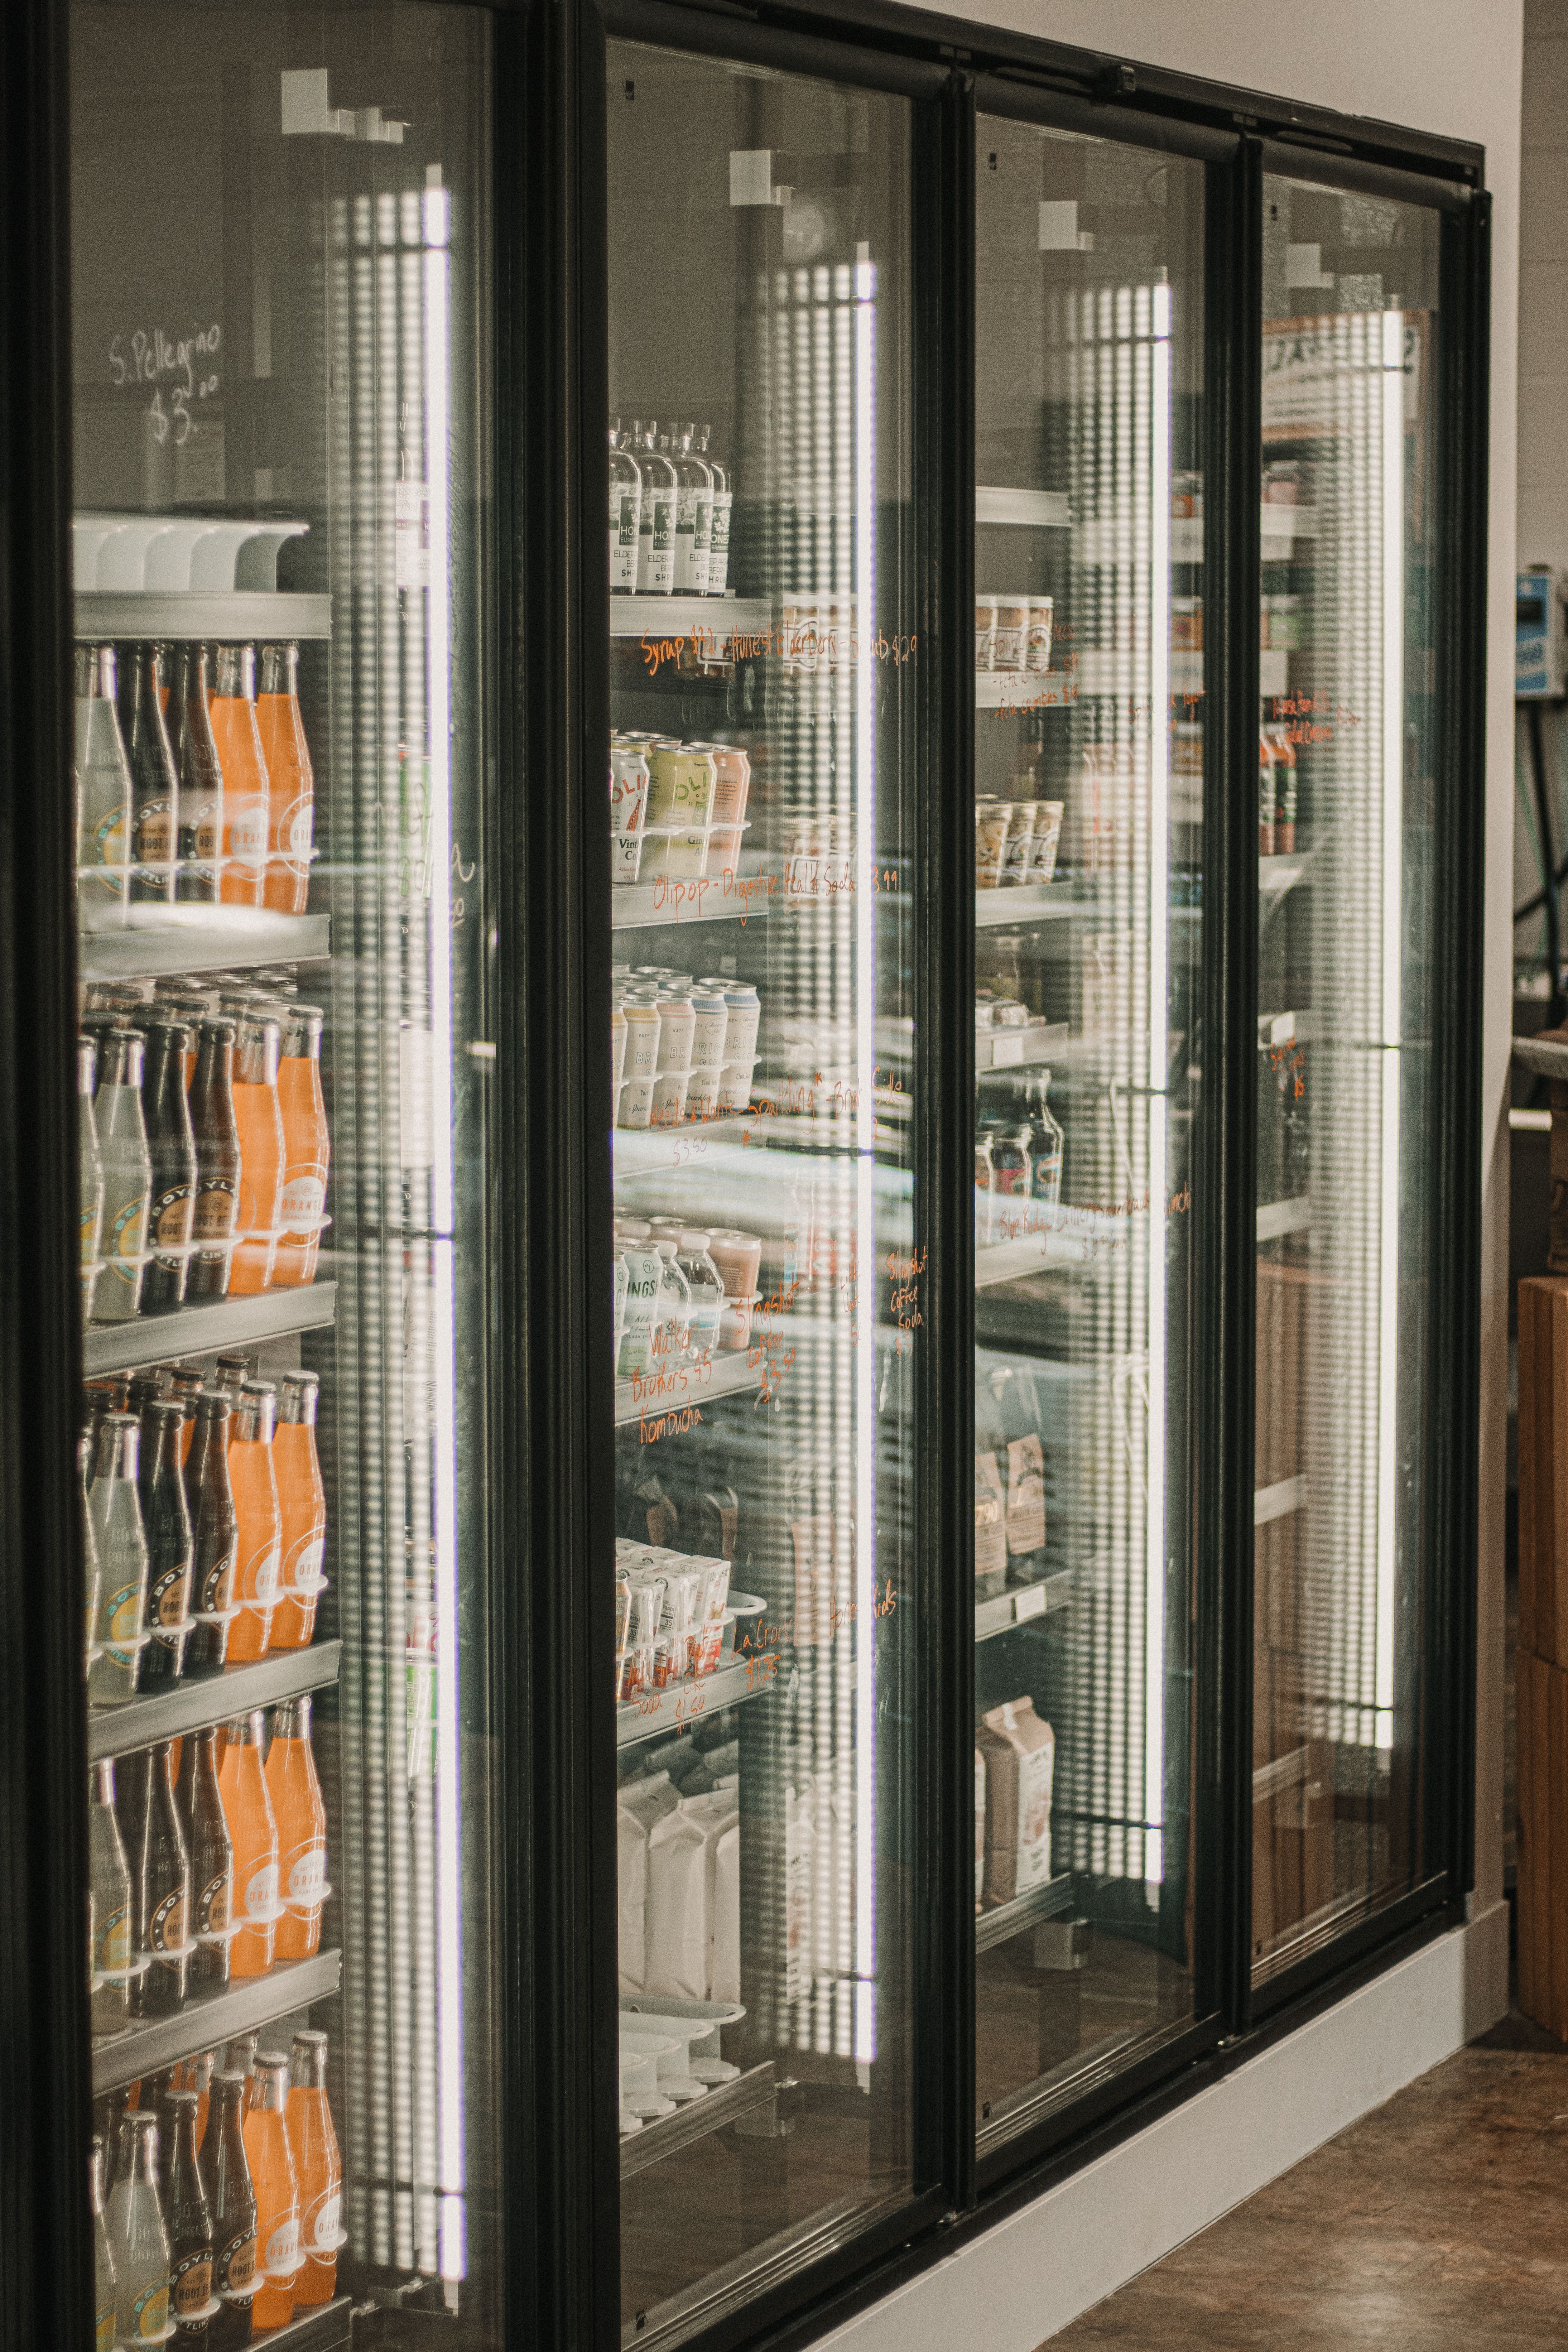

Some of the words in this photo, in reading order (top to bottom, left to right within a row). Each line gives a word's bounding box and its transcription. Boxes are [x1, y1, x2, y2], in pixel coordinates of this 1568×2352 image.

[653, 875, 710, 923] Olipop
[824, 861, 856, 896] Soda
[736, 1271, 800, 1334] Slingshot
[648, 1314, 699, 1357] Walker
